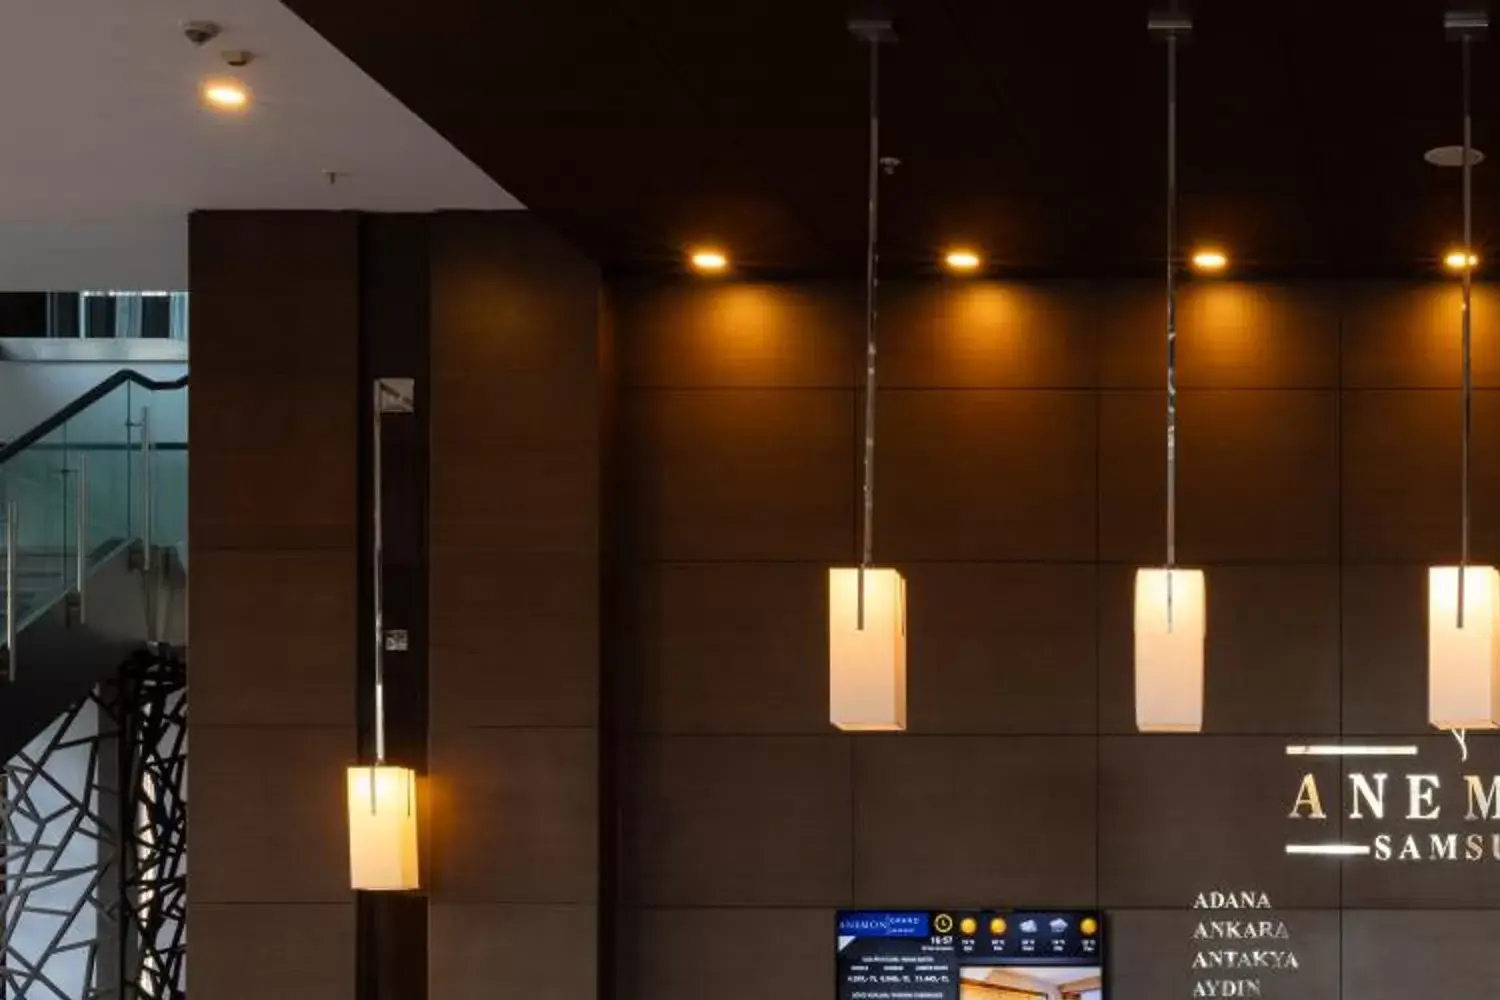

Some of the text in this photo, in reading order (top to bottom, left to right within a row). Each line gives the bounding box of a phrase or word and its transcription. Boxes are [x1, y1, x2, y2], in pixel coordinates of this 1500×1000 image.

[1193, 890, 1272, 909] ADANA
[1192, 920, 1289, 938] ANKARA
[1191, 950, 1299, 969] ANTAKYA
[1192, 979, 1261, 998] AYDIN
